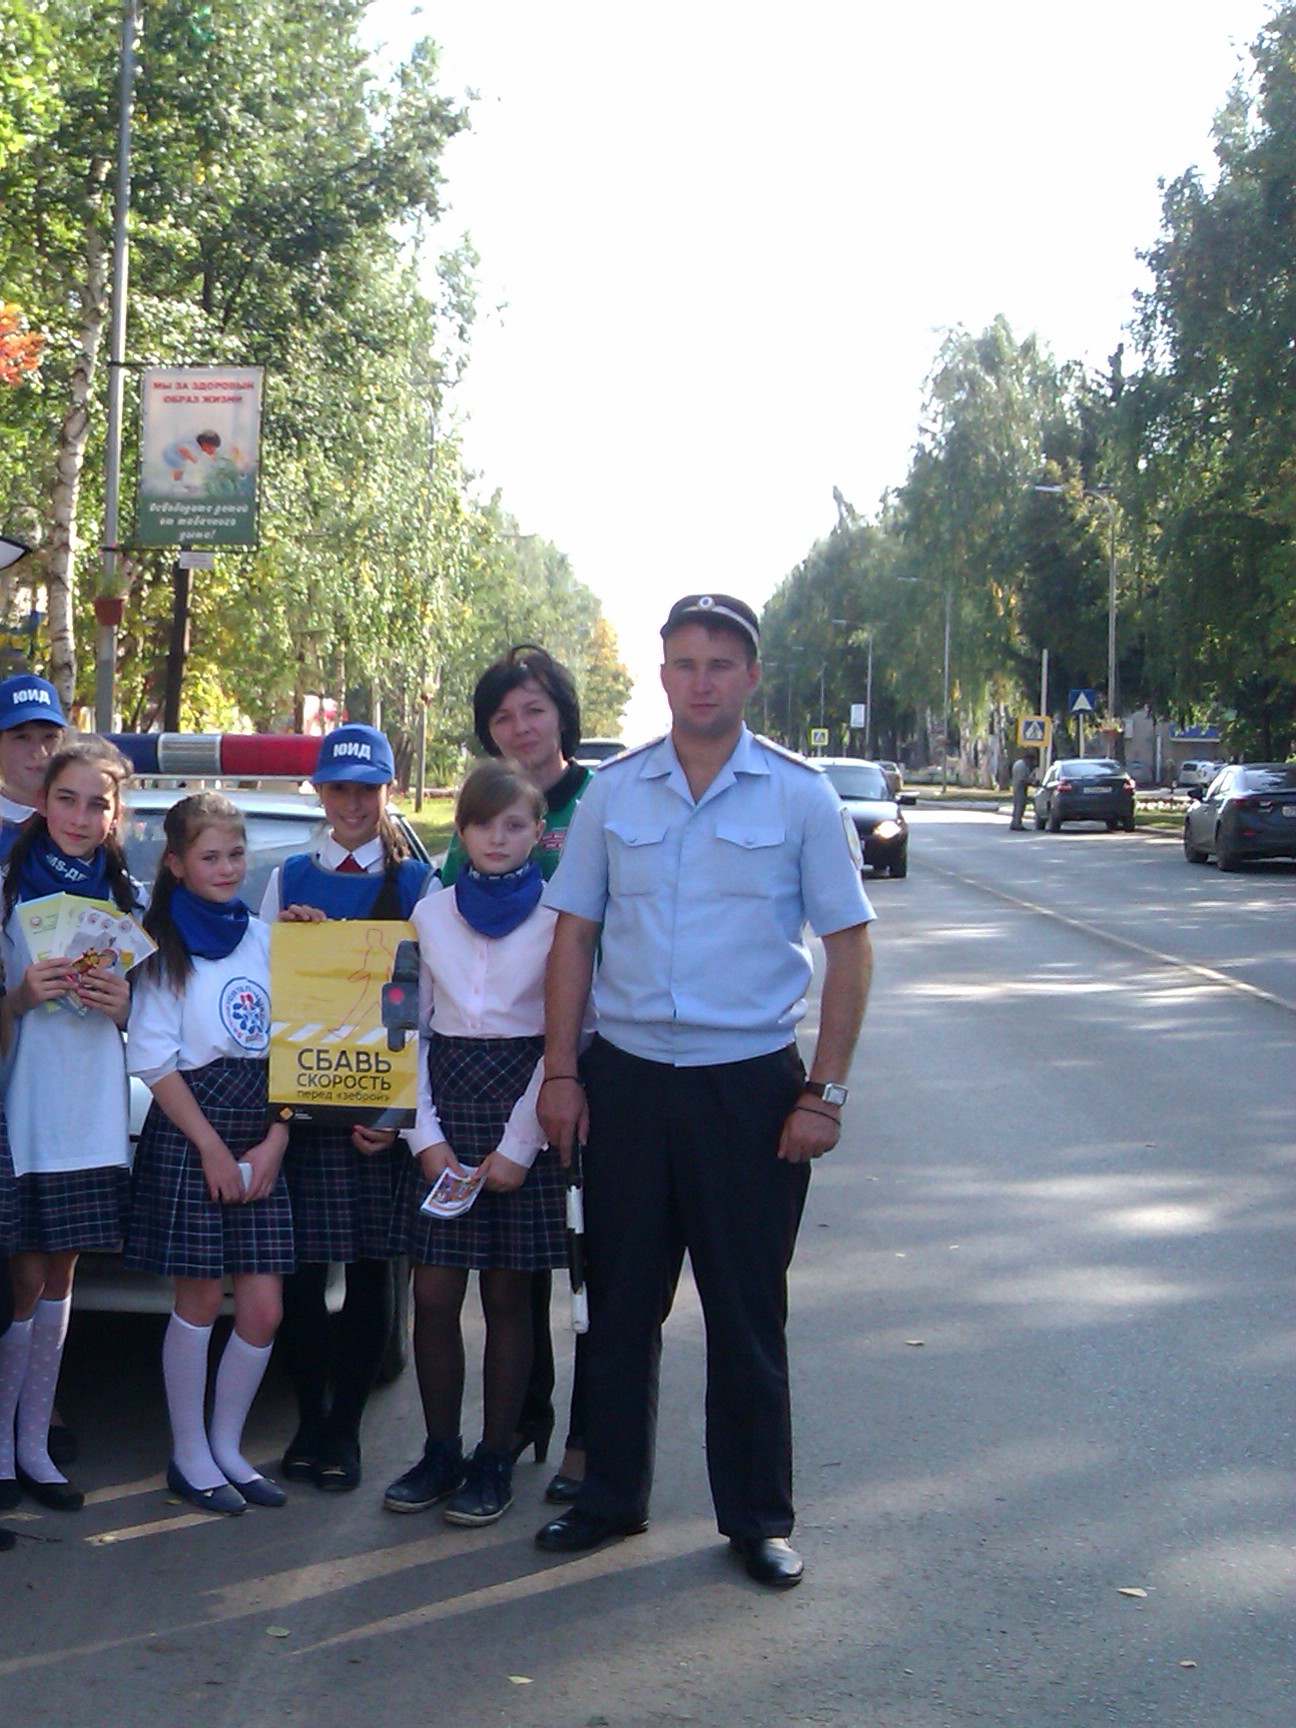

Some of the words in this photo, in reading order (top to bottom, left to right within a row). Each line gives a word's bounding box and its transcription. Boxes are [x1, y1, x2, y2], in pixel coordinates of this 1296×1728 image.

[13, 688, 51, 705] ЮИД
[333, 742, 371, 760] ЮИД
[297, 1048, 392, 1074] СБАВЬ
[296, 1072, 392, 1091] СКОРОСТЬ
[297, 1089, 333, 1100] перед
[336, 1090, 391, 1103] «зеброй»
